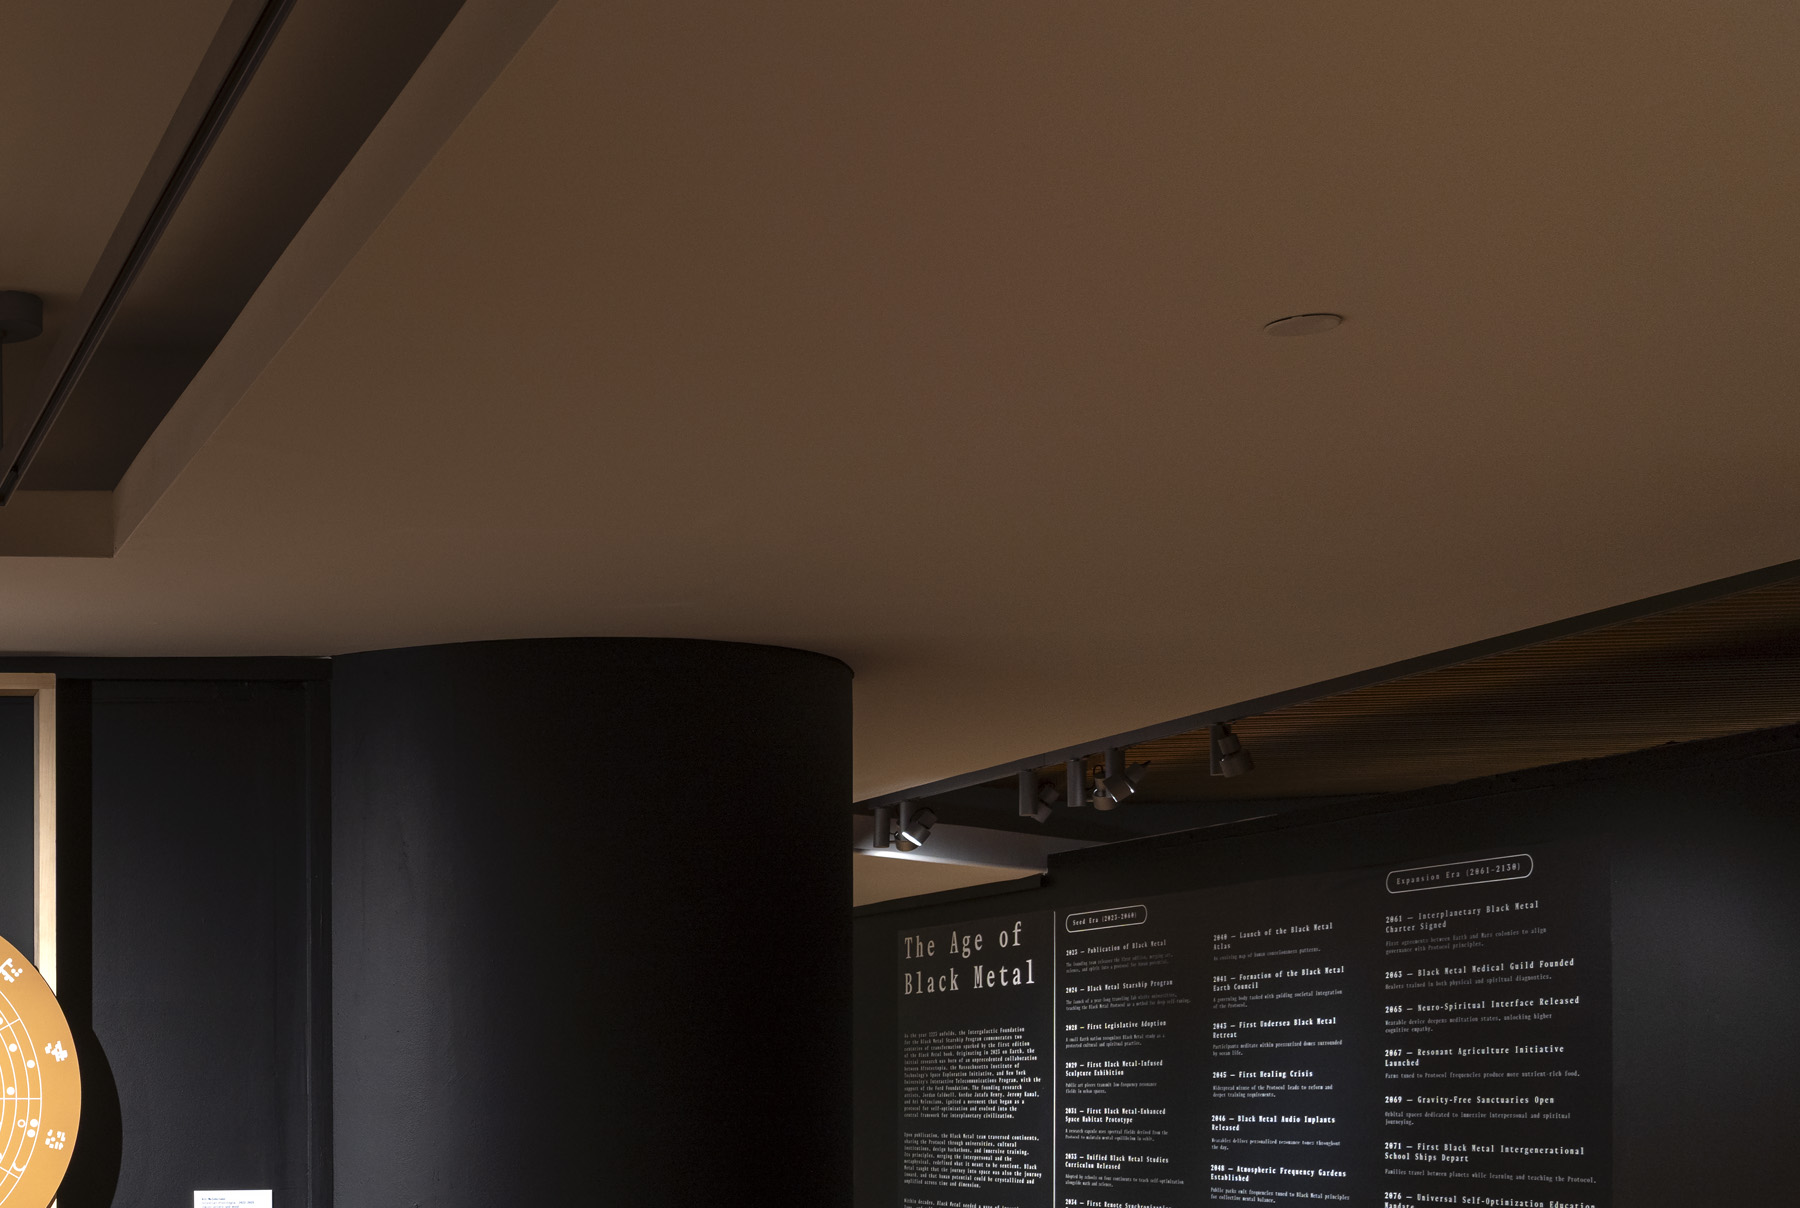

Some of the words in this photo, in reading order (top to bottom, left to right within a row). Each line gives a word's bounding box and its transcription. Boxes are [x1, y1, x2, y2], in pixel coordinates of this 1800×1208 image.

[1396, 874, 1440, 886] Expansion
[1445, 871, 1460, 879] Era
[1466, 863, 1520, 876] (2061-2130)
[1385, 915, 1402, 924] 2061
[1418, 908, 1481, 920] Interplanetary
[1486, 903, 1510, 914] Black
[1514, 900, 1538, 910] Metal
[1385, 925, 1415, 934] Charter
[1420, 920, 1447, 931] Signed
[904, 934, 936, 961] The
[948, 930, 984, 960] Age
[998, 920, 1023, 948] of
[1239, 972, 1272, 981] Formation
[1274, 970, 1283, 978] of
[1286, 969, 1298, 977] the
[1301, 967, 1321, 976] Black
[1324, 965, 1344, 974] Metal
[1385, 970, 1403, 979] 2063
[1417, 968, 1440, 977] Black
[1444, 965, 1466, 975] Metal
[1472, 963, 1504, 973] Medical
[1509, 960, 1534, 970] Guild
[1539, 957, 1574, 968] Founded
[904, 967, 959, 995] Black
[973, 959, 1035, 989] Metal
[1213, 984, 1231, 992] Earth
[1233, 981, 1258, 990] Council
[1385, 1005, 1403, 1014] 2065
[1417, 1000, 1485, 1012] Neuro-Spiritual
[1491, 998, 1534, 1008] Interface
[1539, 995, 1579, 1006] Released
[1384, 1048, 1402, 1057] 2067
[1417, 1048, 1453, 1056] Resonant
[1457, 1046, 1510, 1057] Agriculture
[1515, 1044, 1564, 1054] Initiative
[1385, 1058, 1419, 1067] Launched
[1212, 1071, 1227, 1079] 2045
[1238, 1070, 1257, 1078] First
[1259, 1070, 1287, 1079] Healing
[1289, 1069, 1313, 1078] Crisis
[1384, 1095, 1403, 1104] 2069
[1417, 1095, 1472, 1105] Gravity-Free
[1476, 1095, 1529, 1104] Sanctuaries
[1534, 1095, 1554, 1106] Open
[1065, 1115, 1080, 1124] Space
[1082, 1115, 1103, 1123] Habitat
[1105, 1116, 1133, 1125] Prototype
[1211, 1114, 1226, 1122] 2046
[1237, 1115, 1256, 1123] Black
[1258, 1115, 1277, 1123] Metal
[1280, 1115, 1301, 1123] Audio
[1304, 1115, 1336, 1125] Implants
[1211, 1123, 1240, 1132] Released
[1384, 1142, 1401, 1150] 2071
[1417, 1142, 1439, 1151] First
[1444, 1143, 1467, 1152] Black
[1471, 1144, 1494, 1153] Metal
[1500, 1144, 1584, 1156] Intergenerational
[1384, 1151, 1410, 1160] School
[1414, 1152, 1437, 1163] Ships
[1441, 1153, 1469, 1164] Depart
[1384, 1191, 1402, 1200] 2076
[1417, 1193, 1457, 1204] Universal
[1462, 1195, 1544, 1208] Self-Optimization
